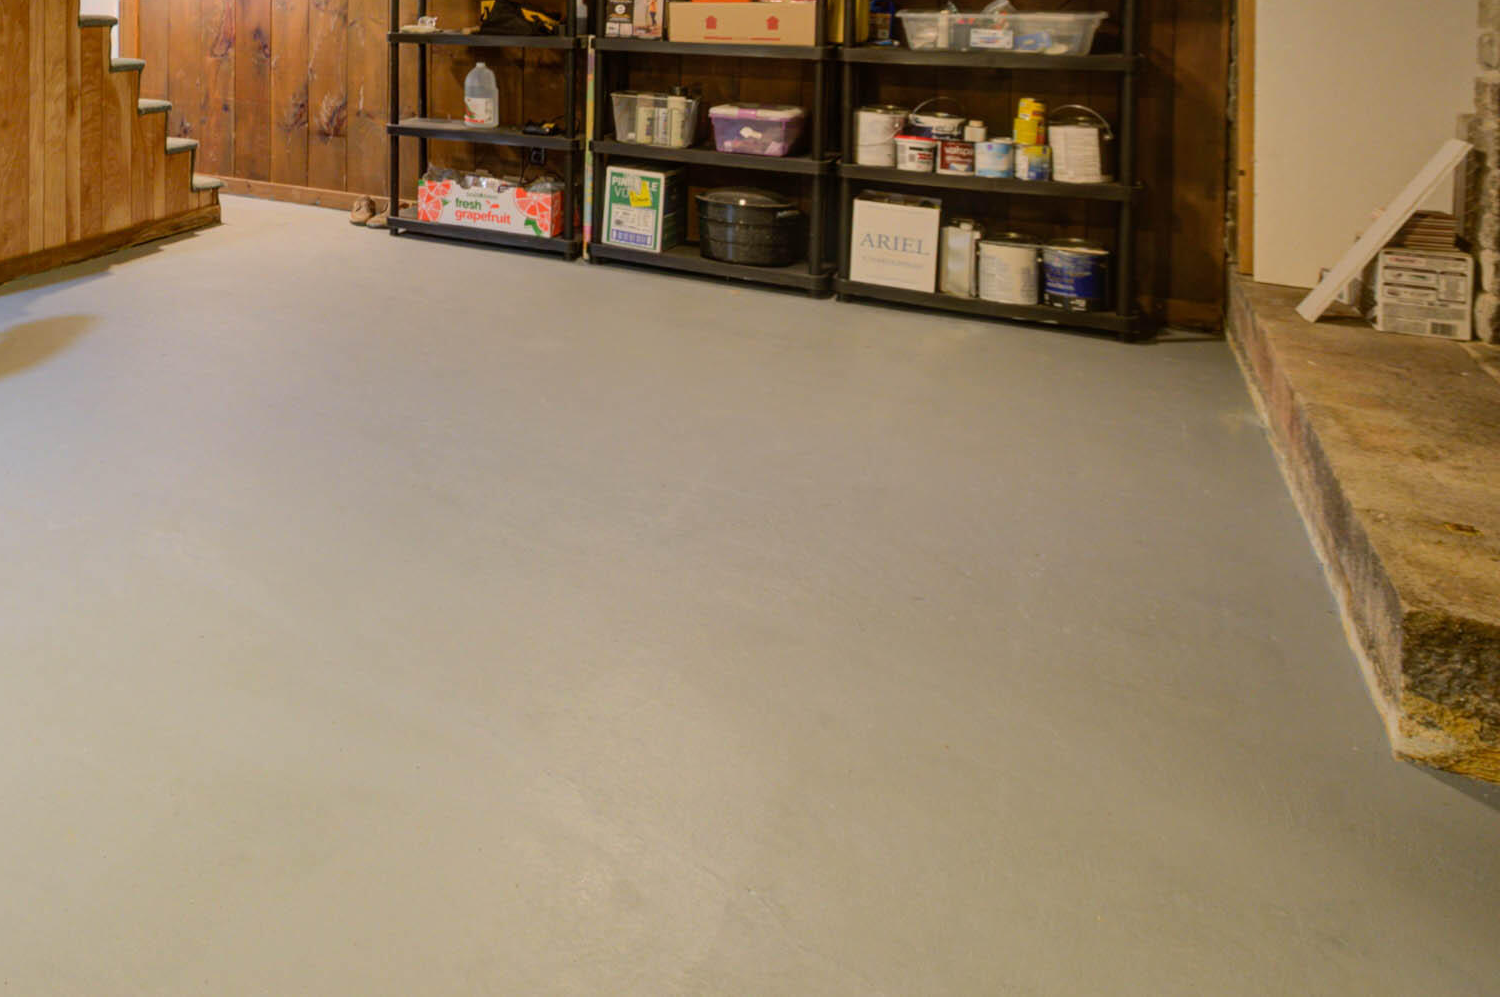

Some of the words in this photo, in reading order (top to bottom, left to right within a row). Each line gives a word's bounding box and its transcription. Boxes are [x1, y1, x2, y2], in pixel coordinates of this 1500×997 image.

[455, 197, 481, 210] fresh
[455, 209, 511, 225] grapefruit
[860, 233, 931, 256] ARIEL
